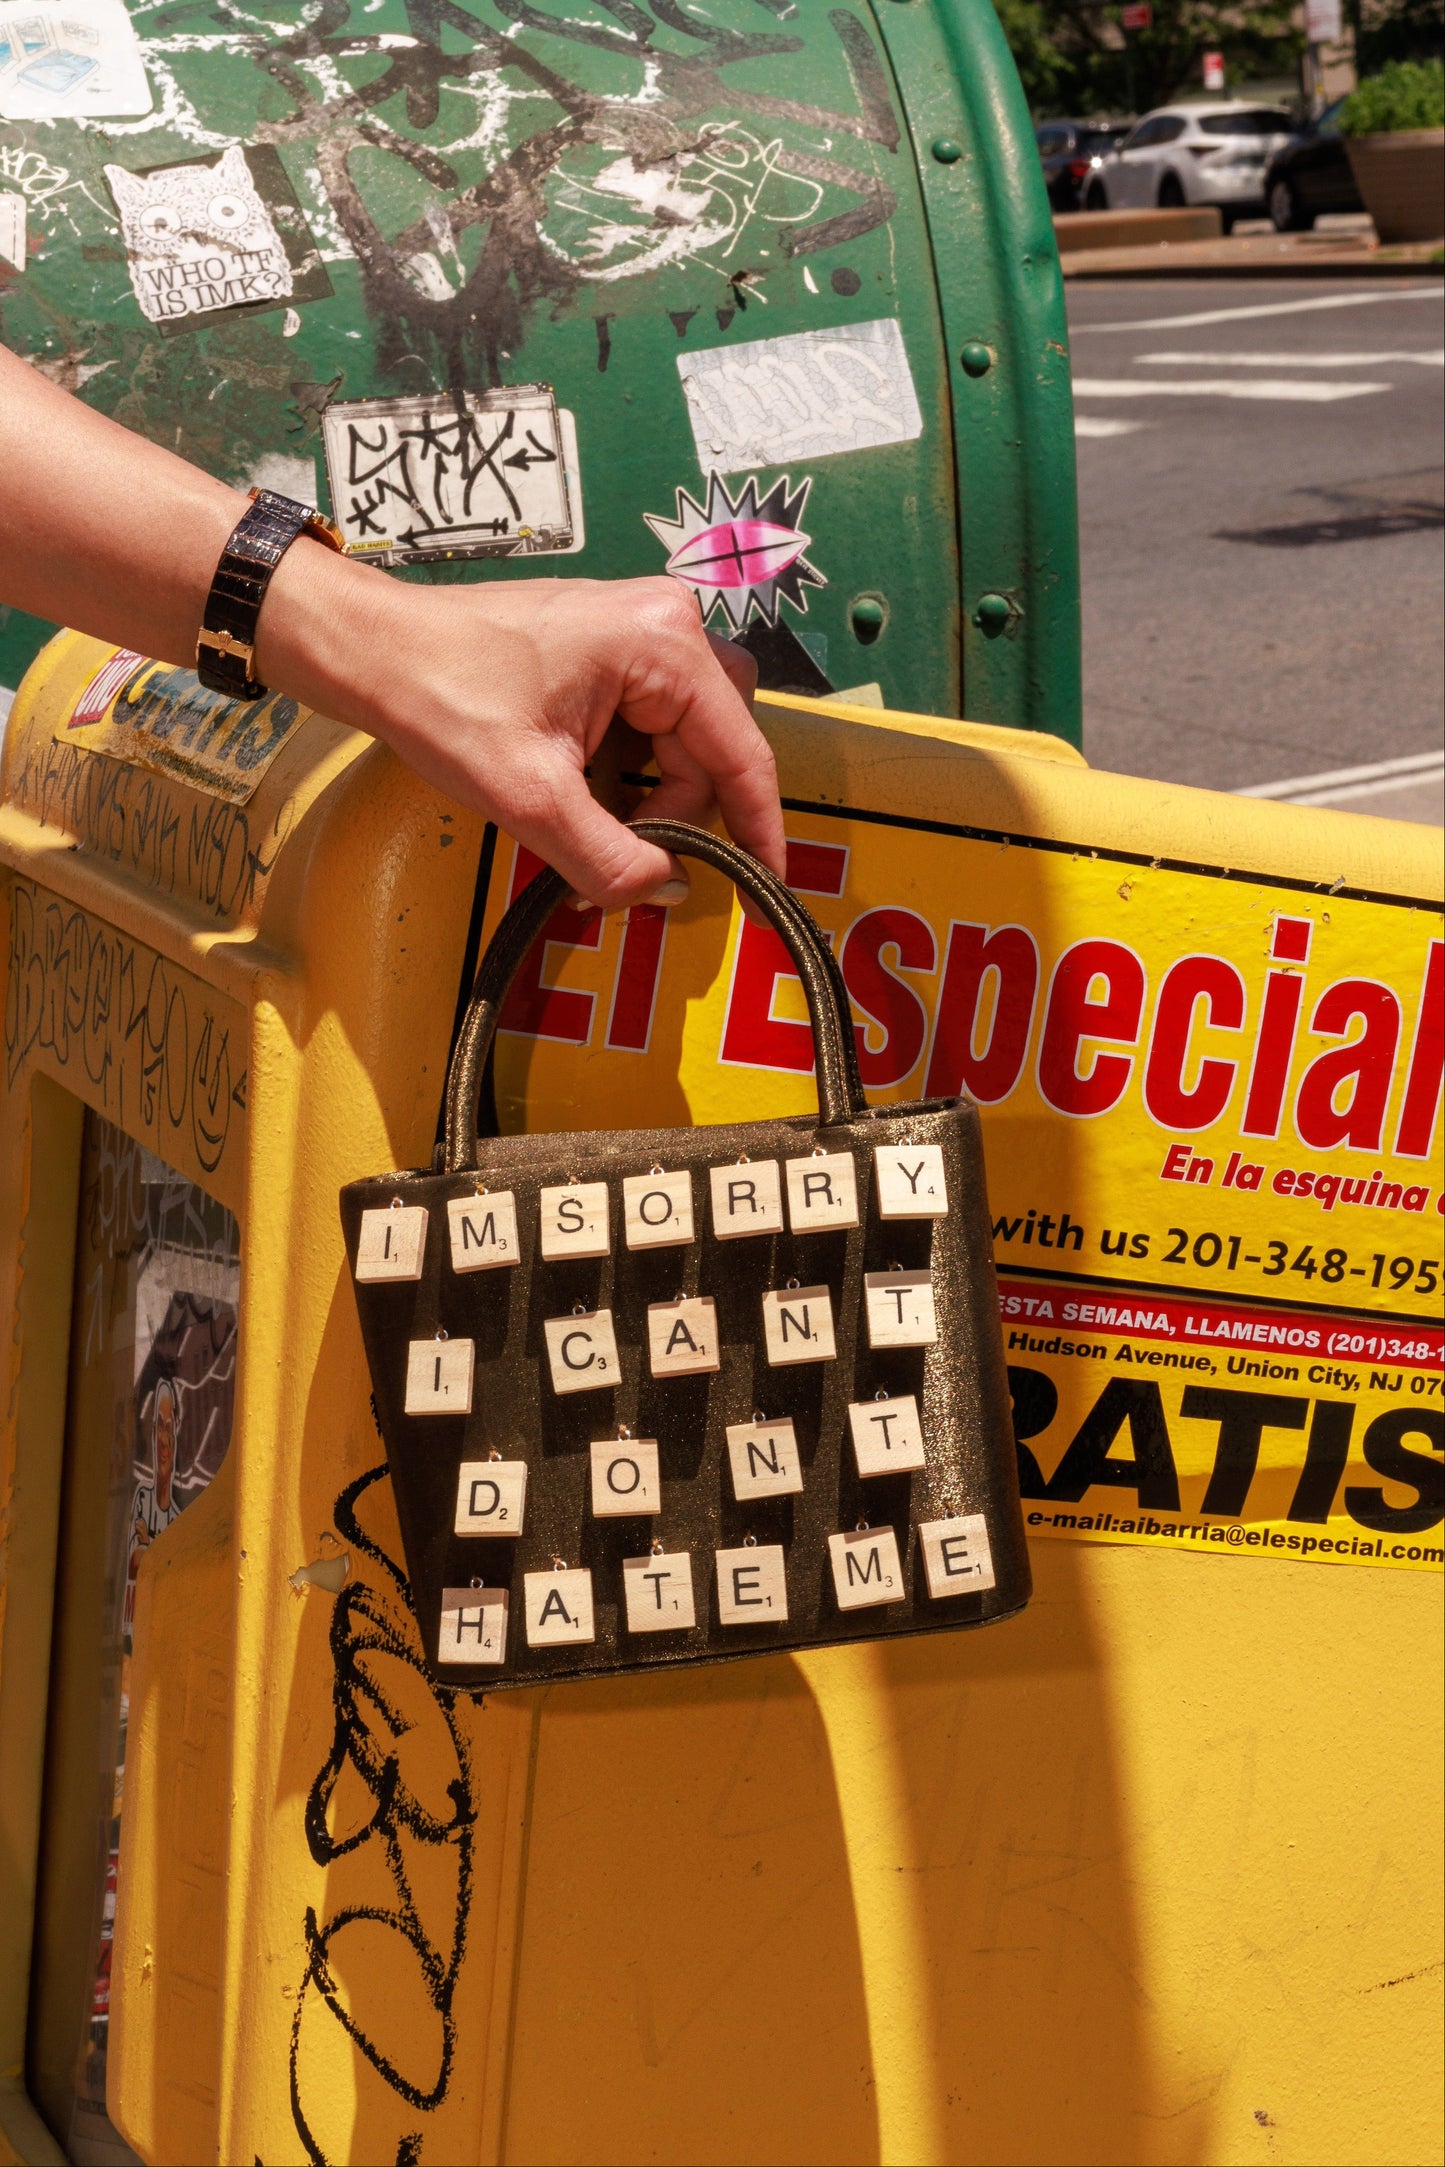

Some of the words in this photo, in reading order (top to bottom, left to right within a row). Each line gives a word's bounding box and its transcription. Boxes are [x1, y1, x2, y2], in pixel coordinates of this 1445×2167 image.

[145, 257, 227, 292] WHO
[231, 248, 274, 277] TF
[151, 289, 188, 318] IS
[190, 271, 283, 310] IMK?
[718, 837, 1444, 1160] Especial
[1160, 1143, 1216, 1187] En
[1220, 1151, 1266, 1192] la
[1272, 1169, 1431, 1212] esquina
[991, 1209, 1084, 1251] with
[1100, 1229, 1151, 1260] us
[1161, 1227, 1444, 1297] 201-348-195
[1062, 1302, 1177, 1336] SEMANA,
[1184, 1316, 1321, 1349] LLAMENOS
[1007, 1331, 1107, 1360] Hudson
[1114, 1343, 1217, 1376] Avenue,
[1226, 1355, 1299, 1381] Union
[1307, 1365, 1361, 1392] City,
[1368, 1371, 1404, 1392] NJ
